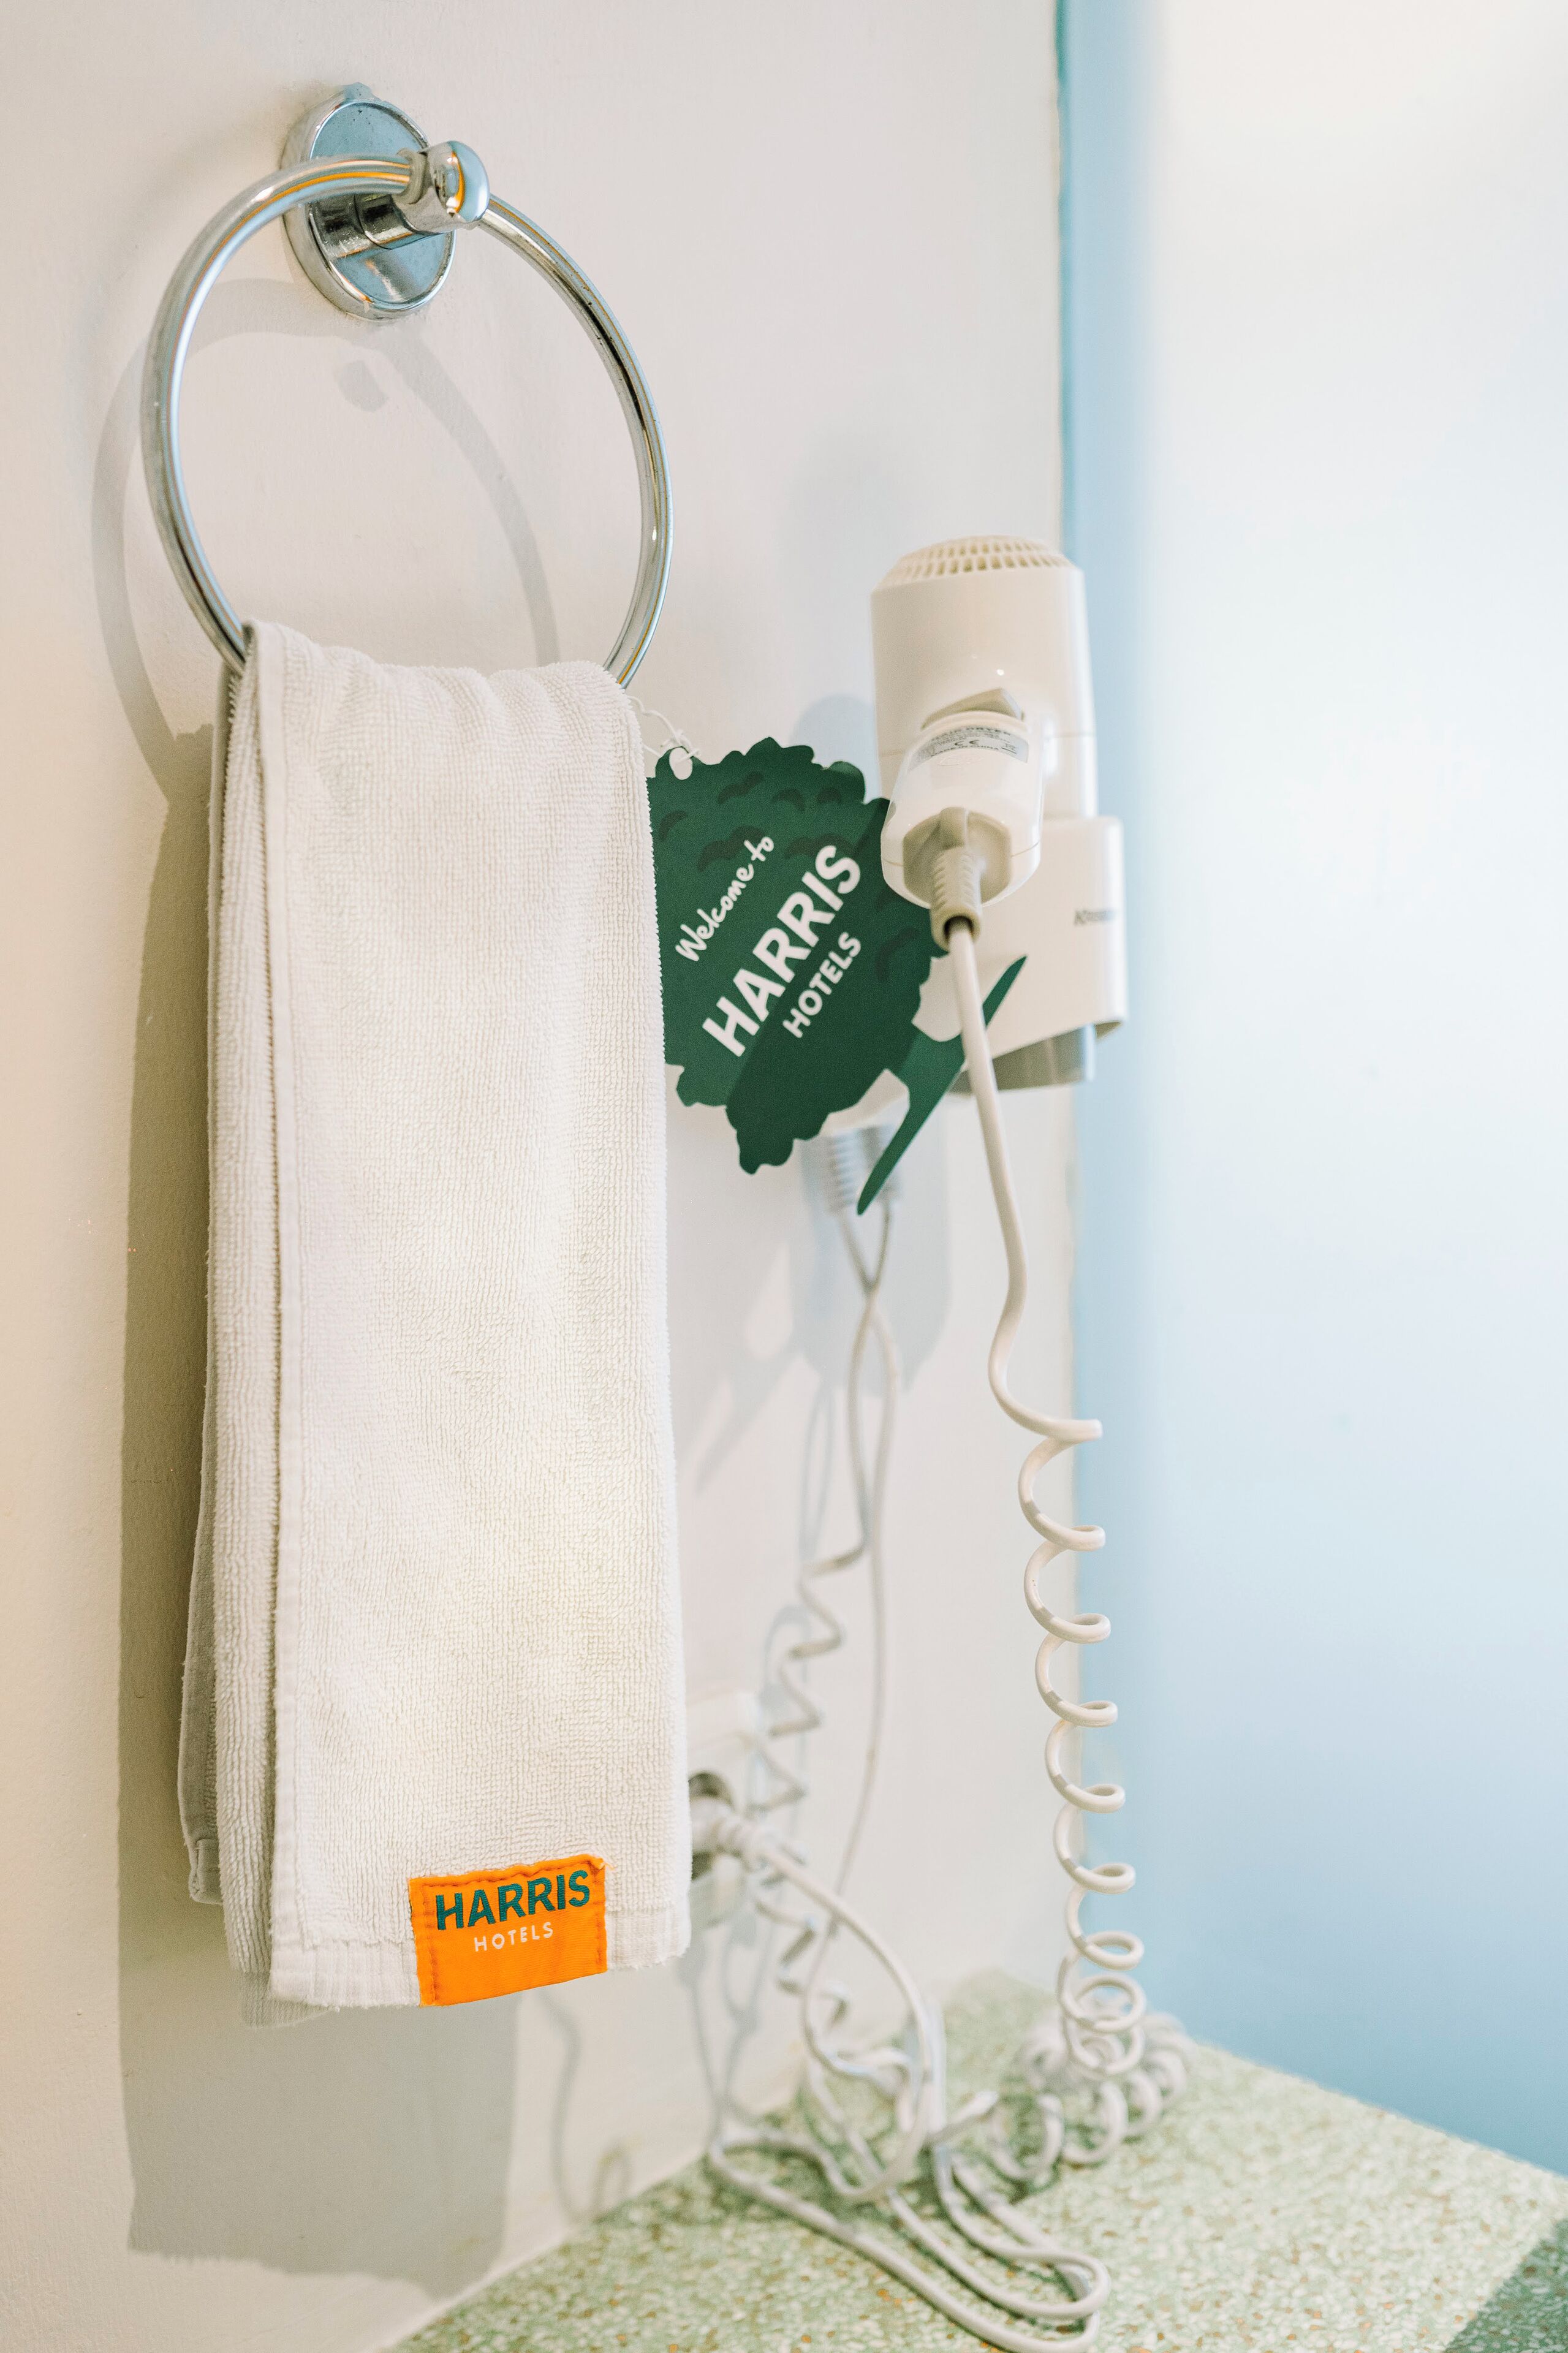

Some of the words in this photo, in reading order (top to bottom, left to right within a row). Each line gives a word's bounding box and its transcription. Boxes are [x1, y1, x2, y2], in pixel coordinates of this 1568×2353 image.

[675, 863, 754, 961] Welcome
[743, 836, 775, 862] to
[702, 845, 860, 1057] HARRIS
[782, 932, 861, 1038] HOTELS
[435, 1870, 590, 1931] HARRIS
[474, 1922, 553, 1952] HOTELS
